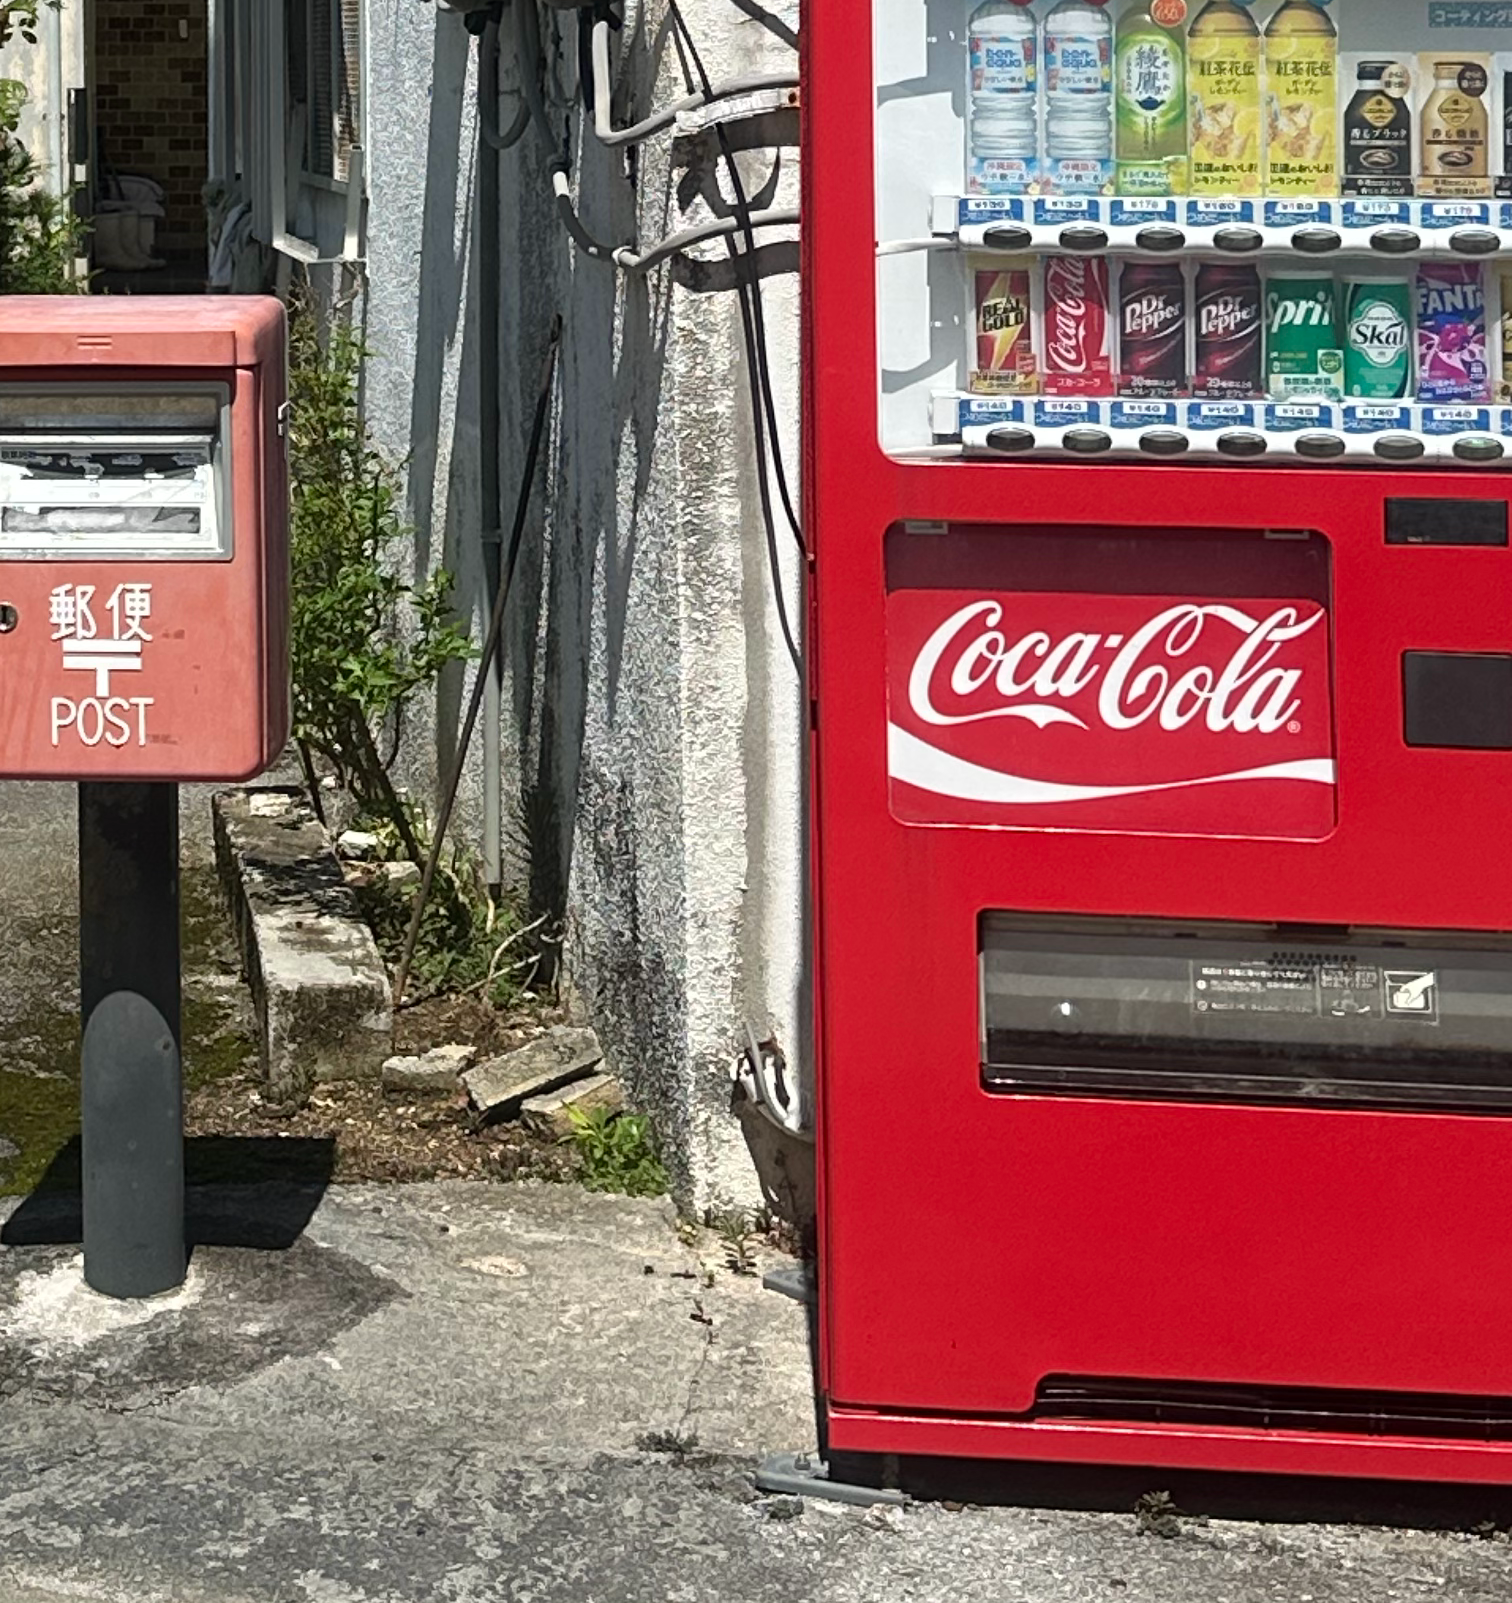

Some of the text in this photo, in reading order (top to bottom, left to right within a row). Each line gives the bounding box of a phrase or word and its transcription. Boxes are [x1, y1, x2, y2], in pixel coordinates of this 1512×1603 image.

[983, 297, 1020, 316] REAL
[1125, 301, 1181, 334] Pepper
[1142, 294, 1167, 314] Dr
[1201, 303, 1257, 335] Pepper
[1219, 296, 1243, 316] Dr
[983, 311, 1024, 332] GOLD
[49, 583, 153, 642] 郵便
[908, 600, 1326, 733] Coca-Cola
[51, 697, 155, 747] POST
